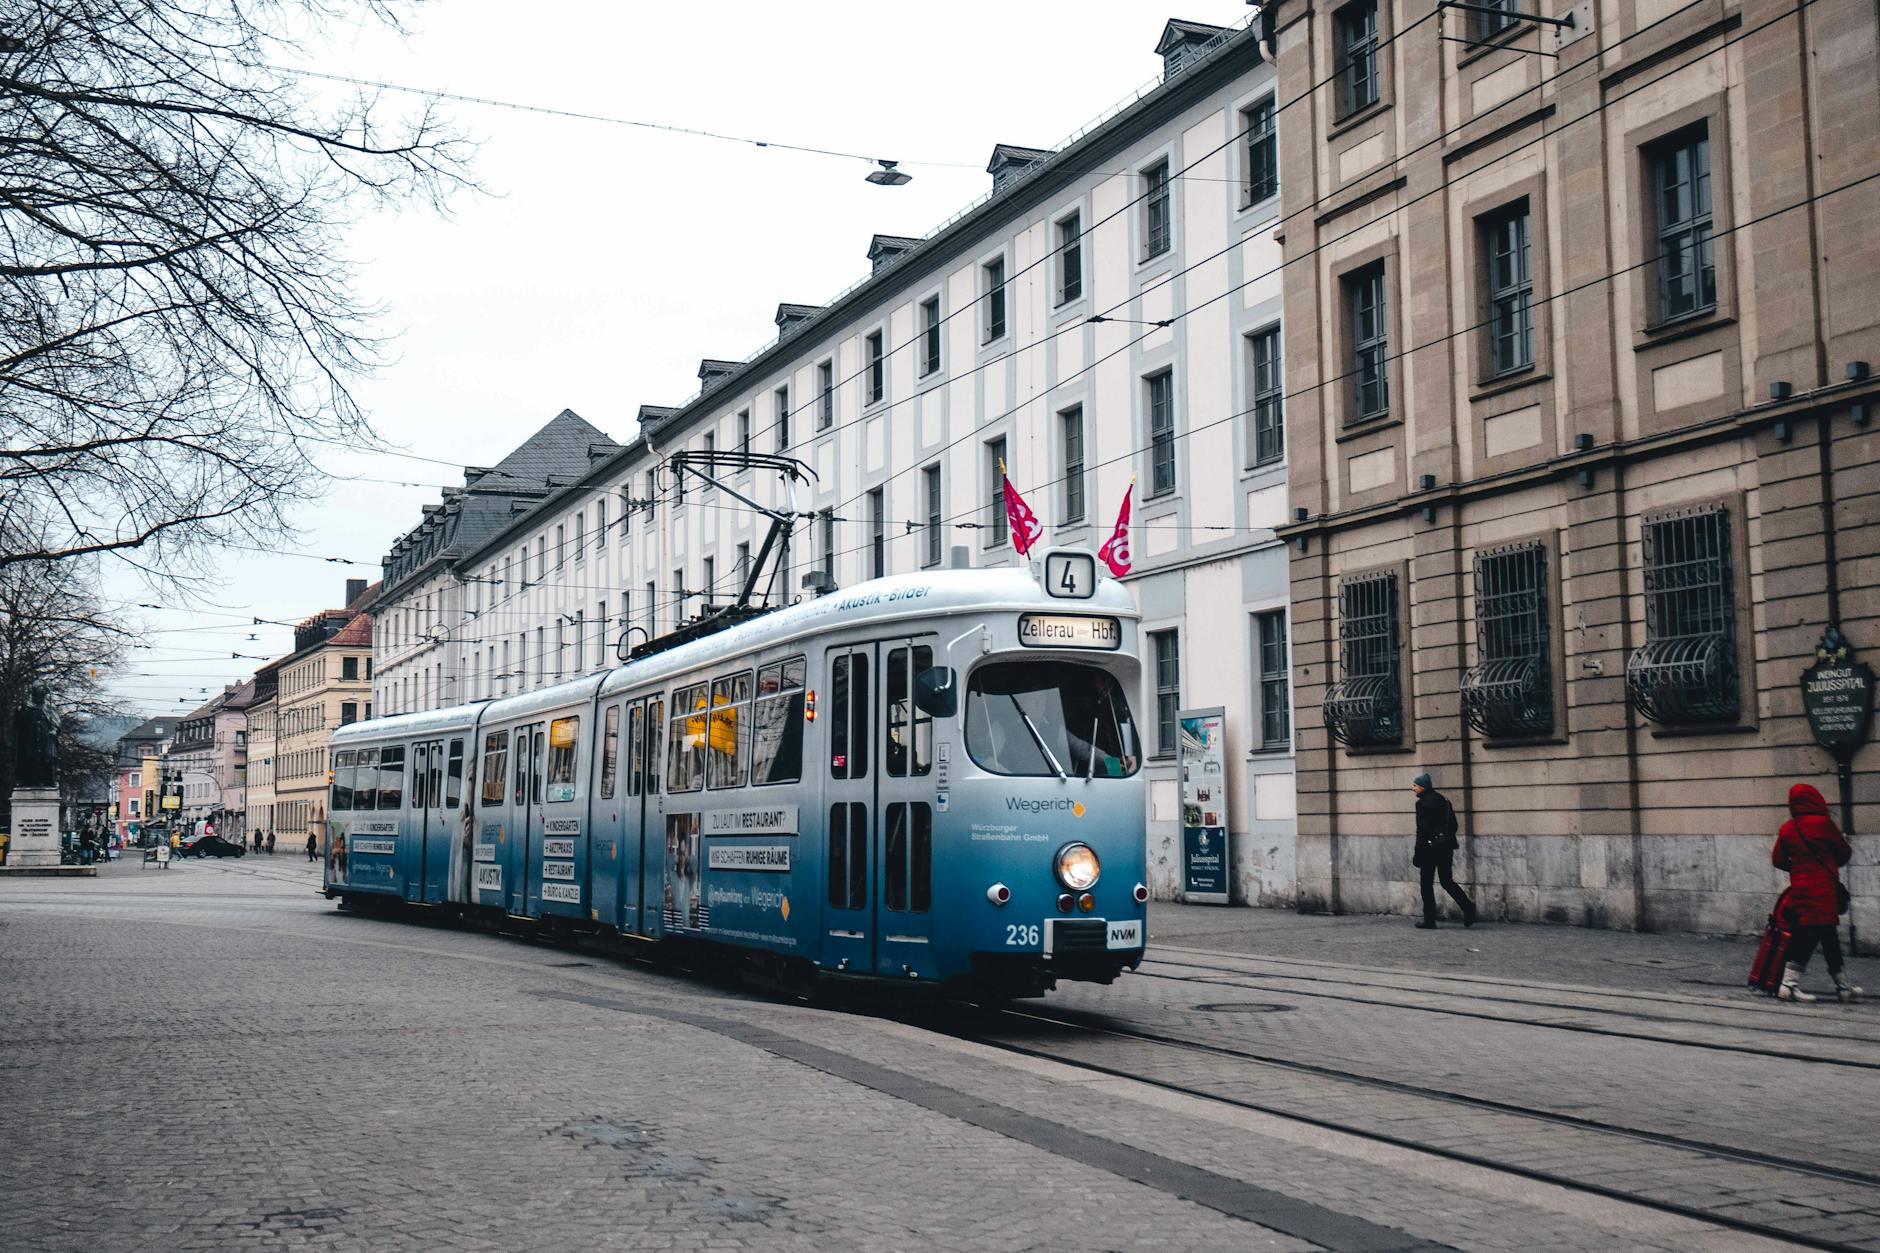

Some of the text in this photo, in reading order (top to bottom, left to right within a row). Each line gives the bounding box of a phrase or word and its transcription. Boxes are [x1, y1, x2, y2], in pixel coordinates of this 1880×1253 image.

[1060, 560, 1076, 594] 4
[1022, 618, 1074, 638] Zellerau
[1817, 668, 1853, 680] WEINGUT
[1807, 678, 1866, 693] JULIUSSPITAL
[1006, 797, 1075, 814] Wegerich
[550, 820, 579, 832] KINDERGARTEN
[971, 823, 1018, 832] Würzburger
[971, 832, 1049, 842] Straßenbahn GmbH
[746, 850, 766, 865] RUHIGE
[767, 847, 788, 865] RÄUME
[548, 864, 573, 877] RESTAURANT
[752, 886, 784, 911] Wegerich
[1006, 924, 1039, 946] 236
[1111, 929, 1136, 941] NVM
